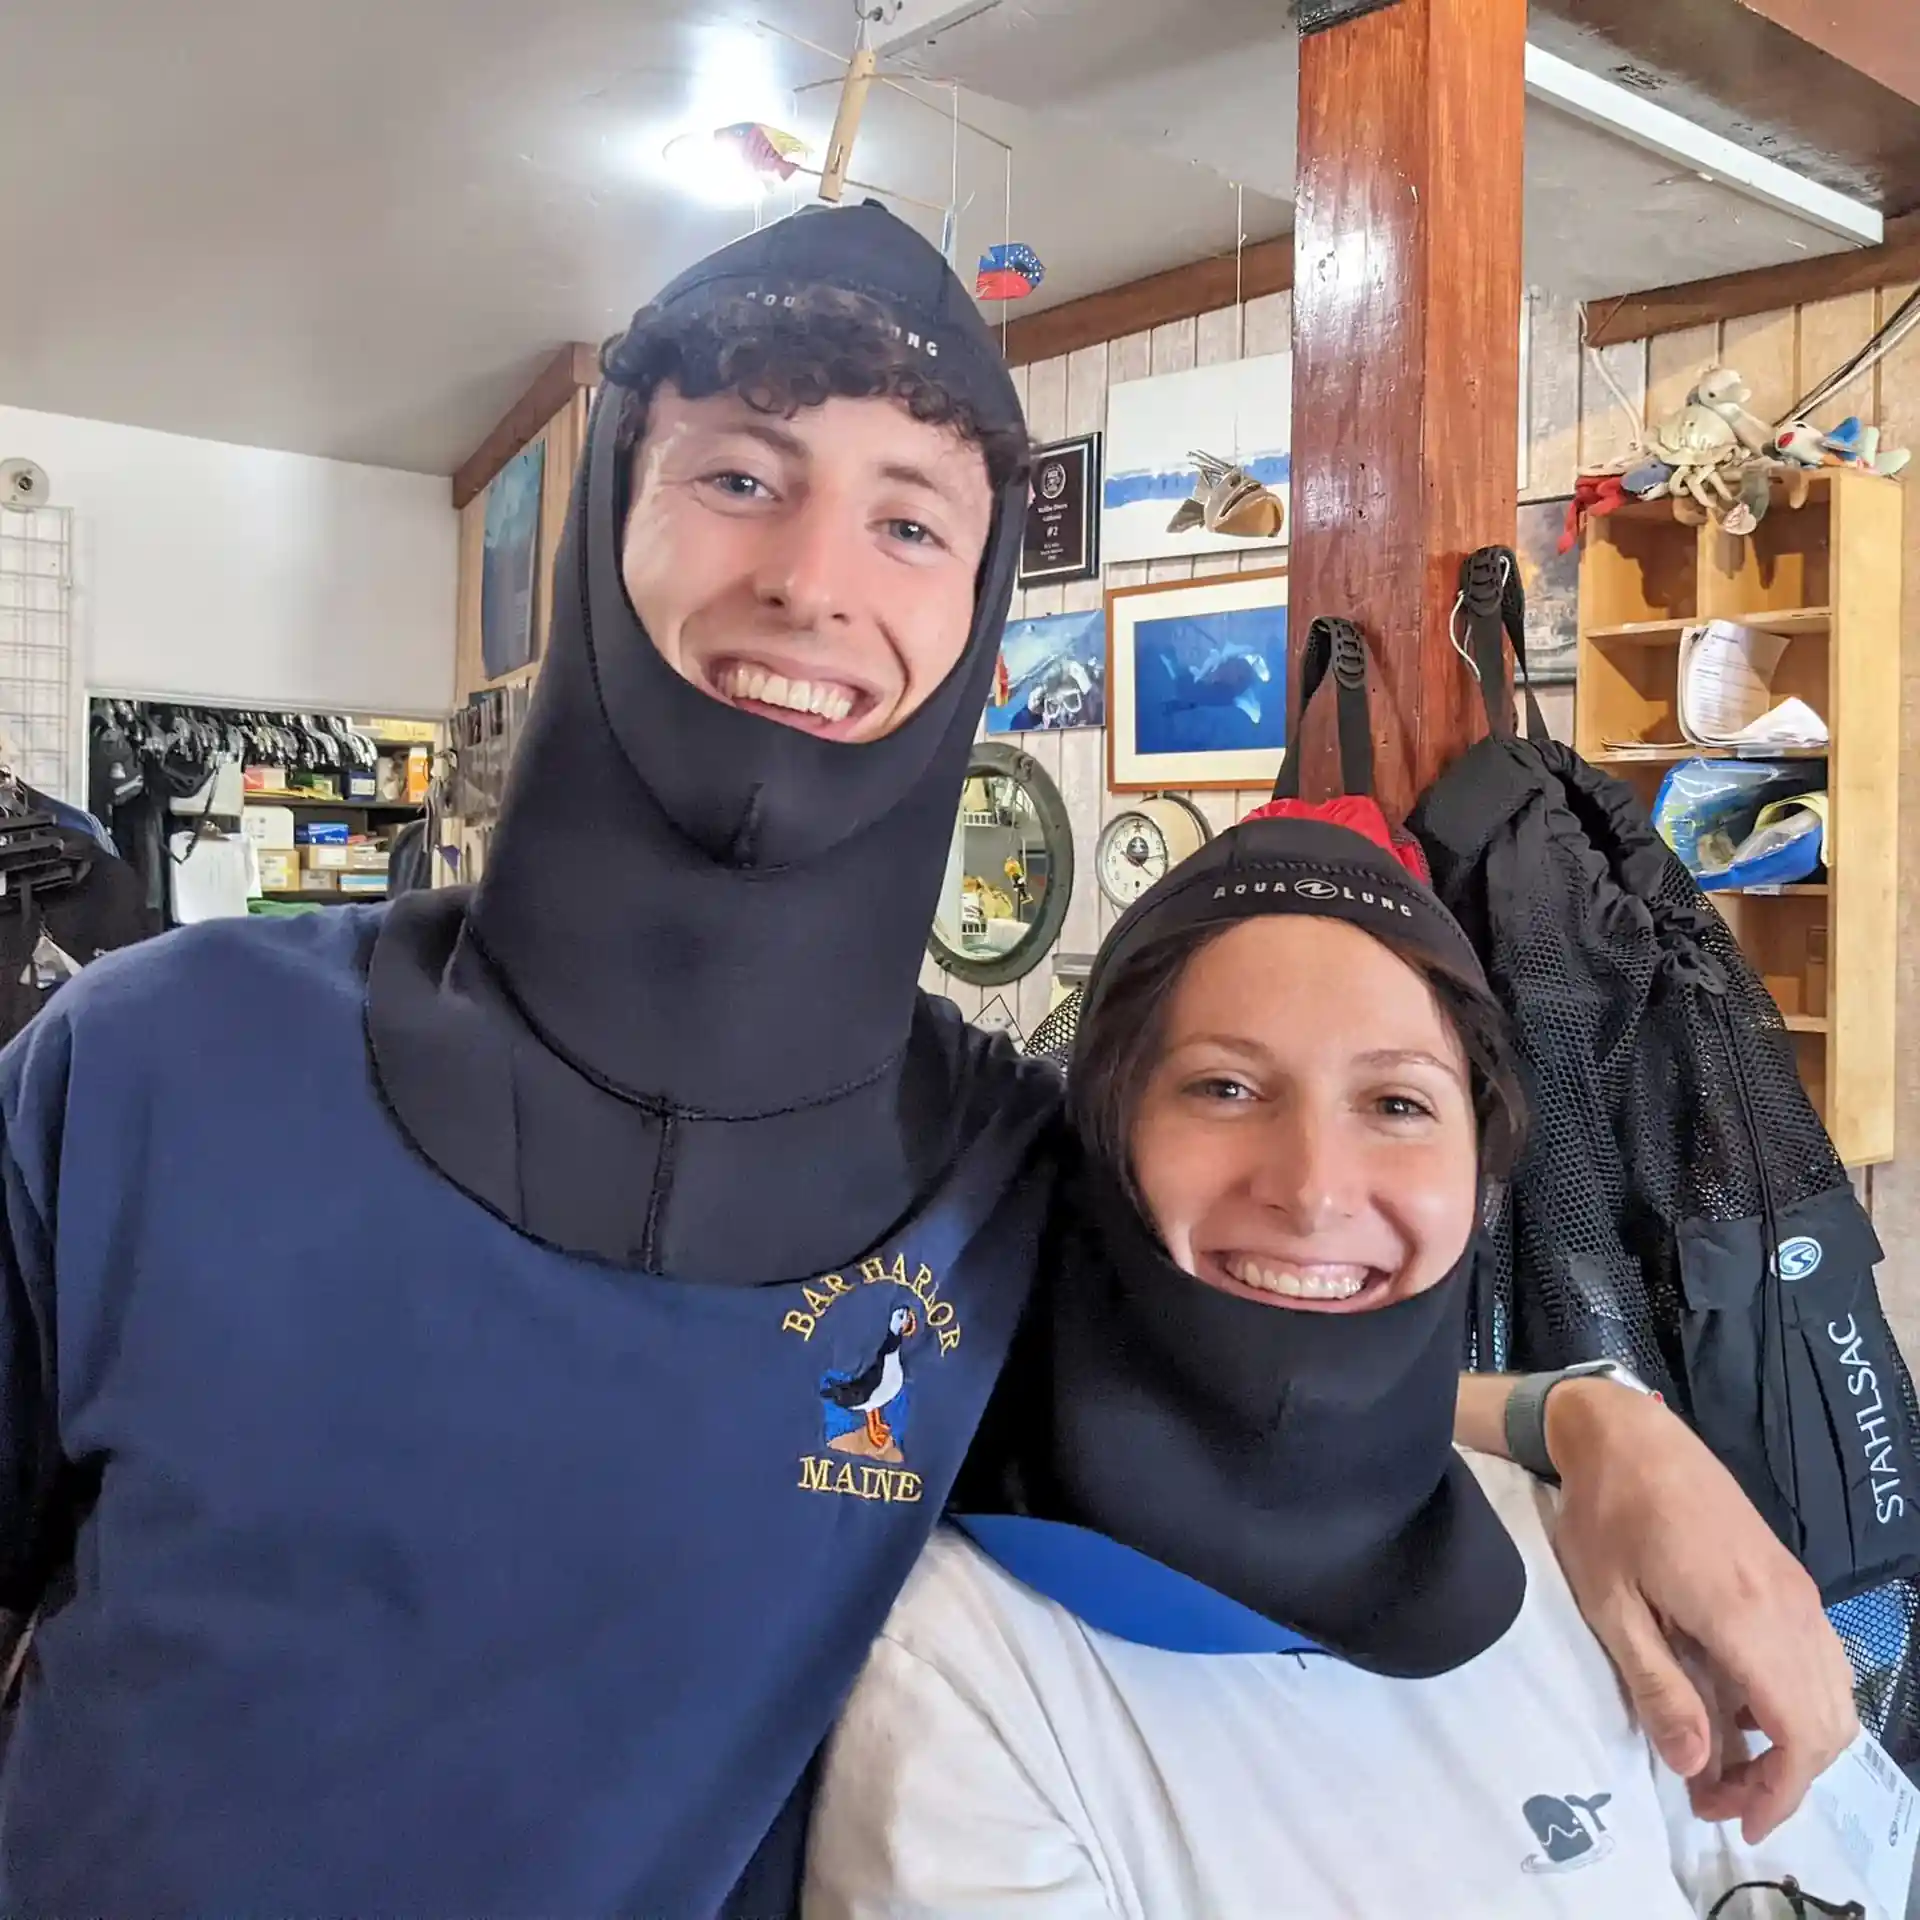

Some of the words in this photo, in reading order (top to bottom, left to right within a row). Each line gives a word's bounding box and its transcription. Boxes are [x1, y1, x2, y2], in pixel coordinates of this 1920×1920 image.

[1213, 881, 1288, 899] AQUA
[1343, 886, 1413, 917] LUNG
[782, 1273, 853, 1342] BAR
[1827, 1312, 1905, 1524] STAHLSAC
[797, 1455, 924, 1503] MAINE
